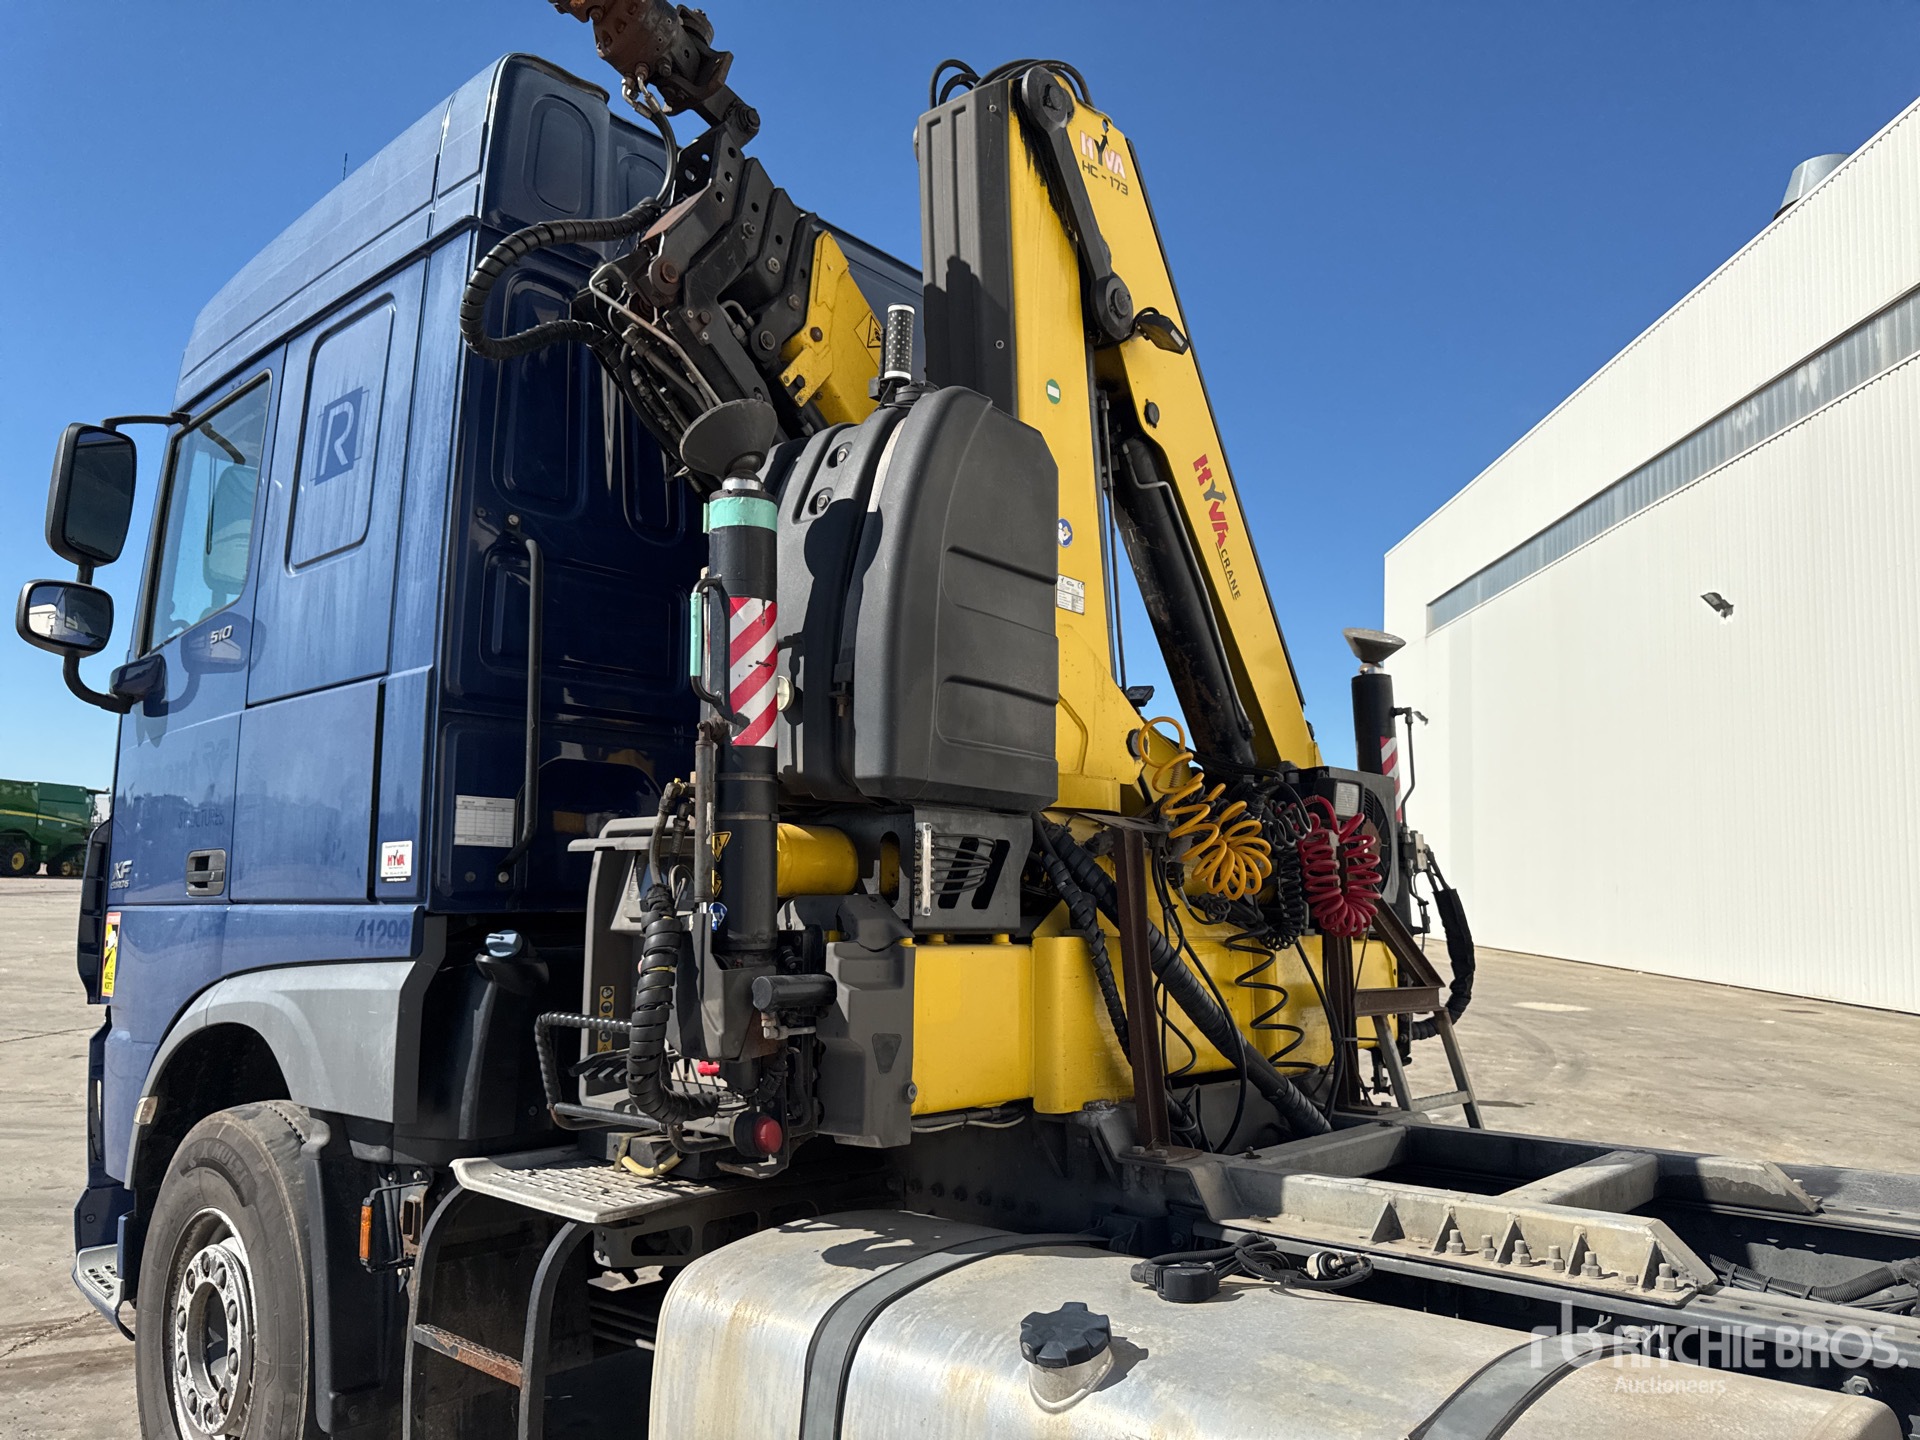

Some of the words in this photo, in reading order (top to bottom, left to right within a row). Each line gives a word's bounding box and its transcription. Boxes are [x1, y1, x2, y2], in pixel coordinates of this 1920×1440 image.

[1080, 128, 1126, 180] HYVA
[1192, 453, 1229, 549] HYVA
[1220, 549, 1241, 600] CRANE
[210, 624, 233, 645] 510
[111, 859, 134, 881] XF
[387, 851, 406, 867] HYVA
